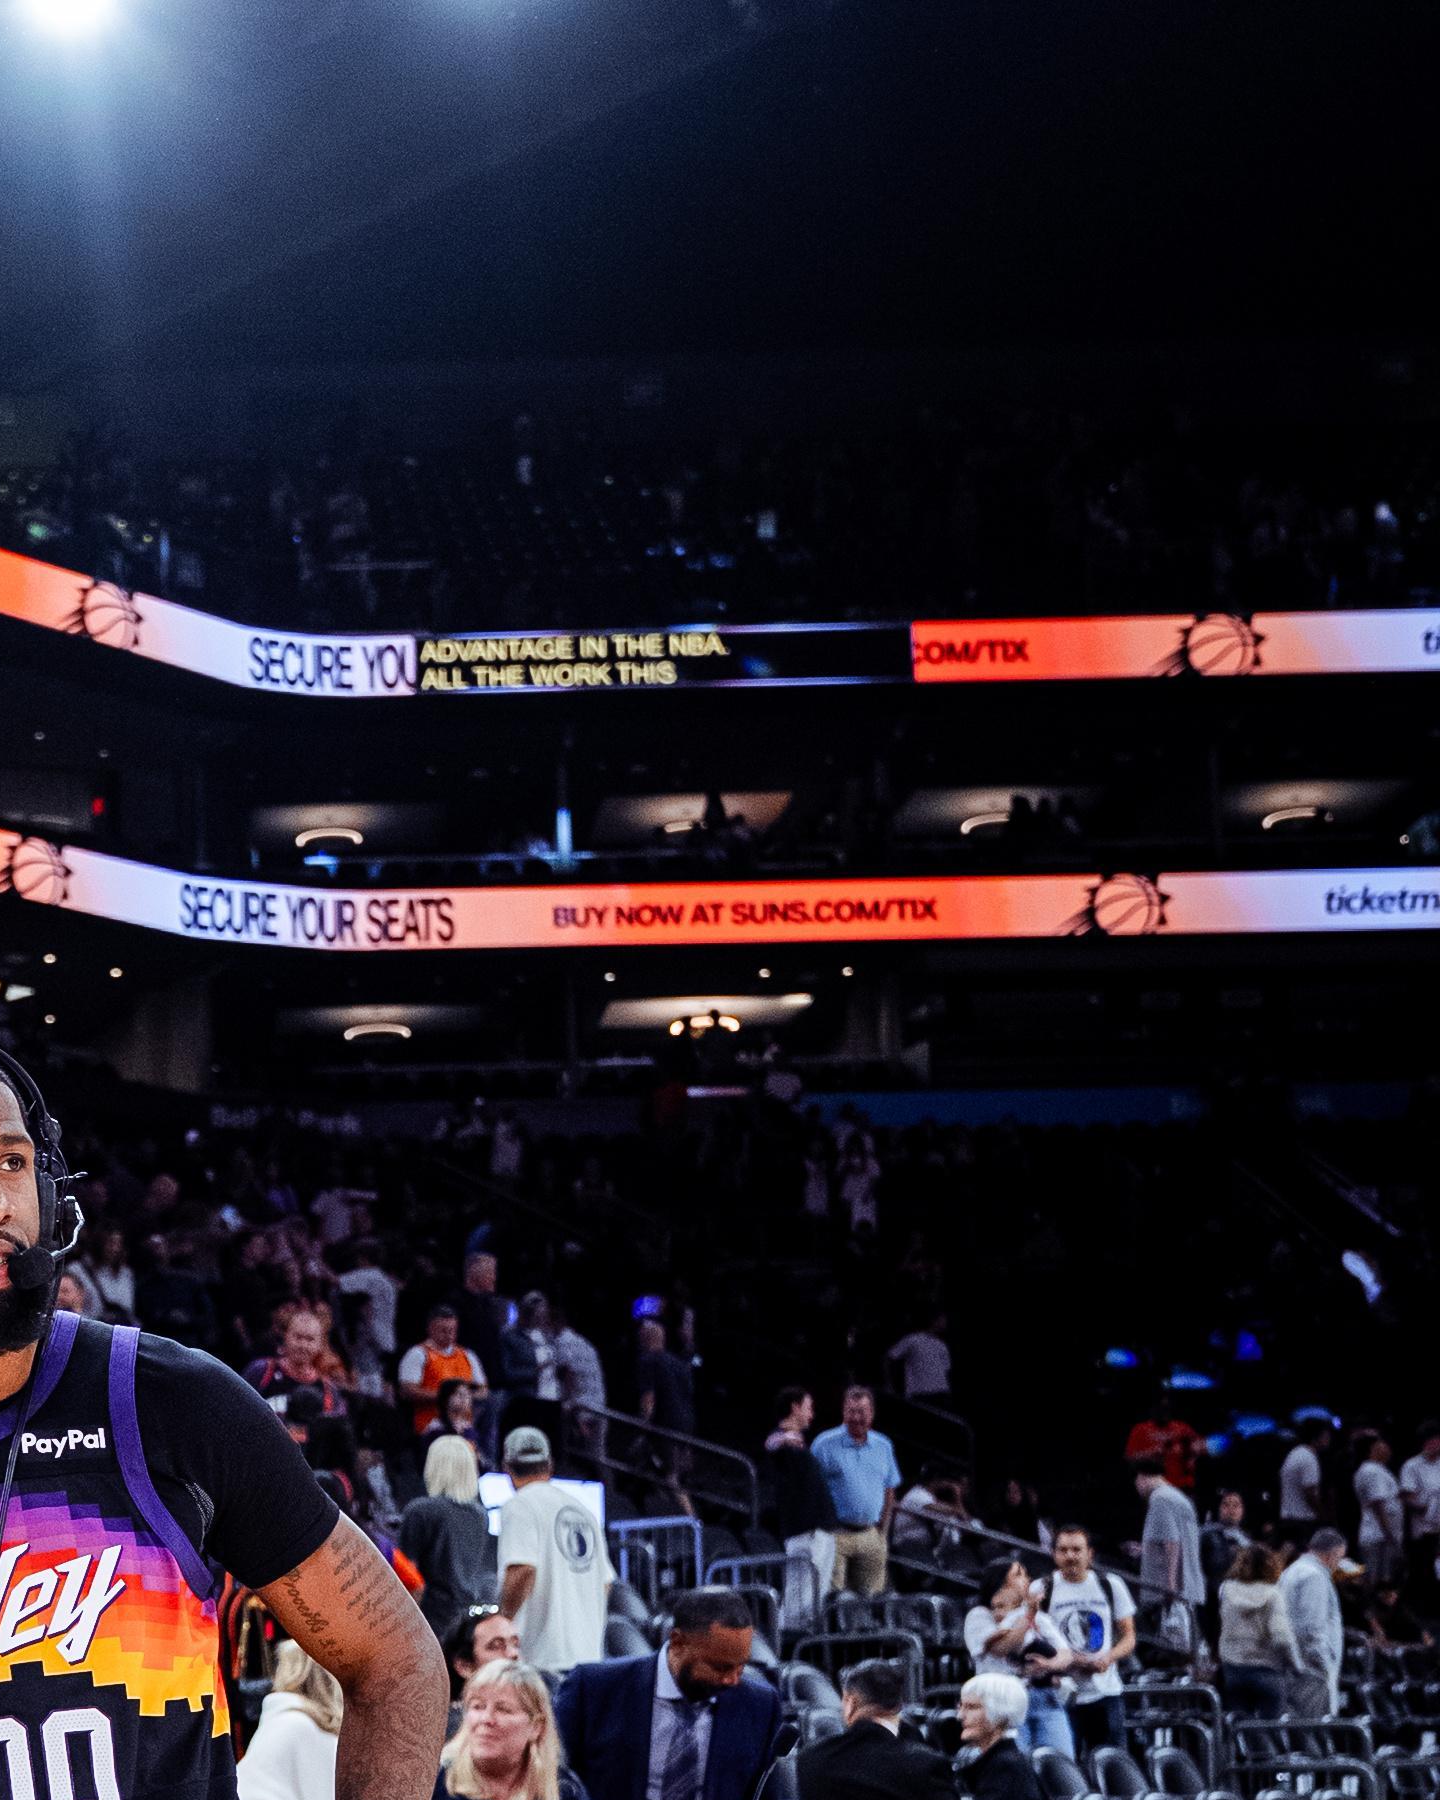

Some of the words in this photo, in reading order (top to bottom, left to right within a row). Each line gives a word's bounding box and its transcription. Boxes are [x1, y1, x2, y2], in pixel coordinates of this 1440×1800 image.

[248, 637, 353, 690] SECURE
[421, 633, 573, 663] ADVANTAGE
[579, 634, 607, 658] IN
[614, 632, 665, 657] THE
[421, 667, 468, 690] ALL
[476, 665, 526, 688] THE
[531, 663, 612, 687] WORK
[616, 661, 678, 685] THIS
[179, 882, 278, 937] SECURE
[284, 893, 358, 943] YOUR
[365, 896, 455, 943] SEATS
[552, 904, 607, 930] BUY
[615, 903, 683, 927] NOW
[691, 901, 726, 925] AT
[731, 896, 938, 926] SUNS.COM/TIX
[21, 1427, 106, 1458] PayPal
